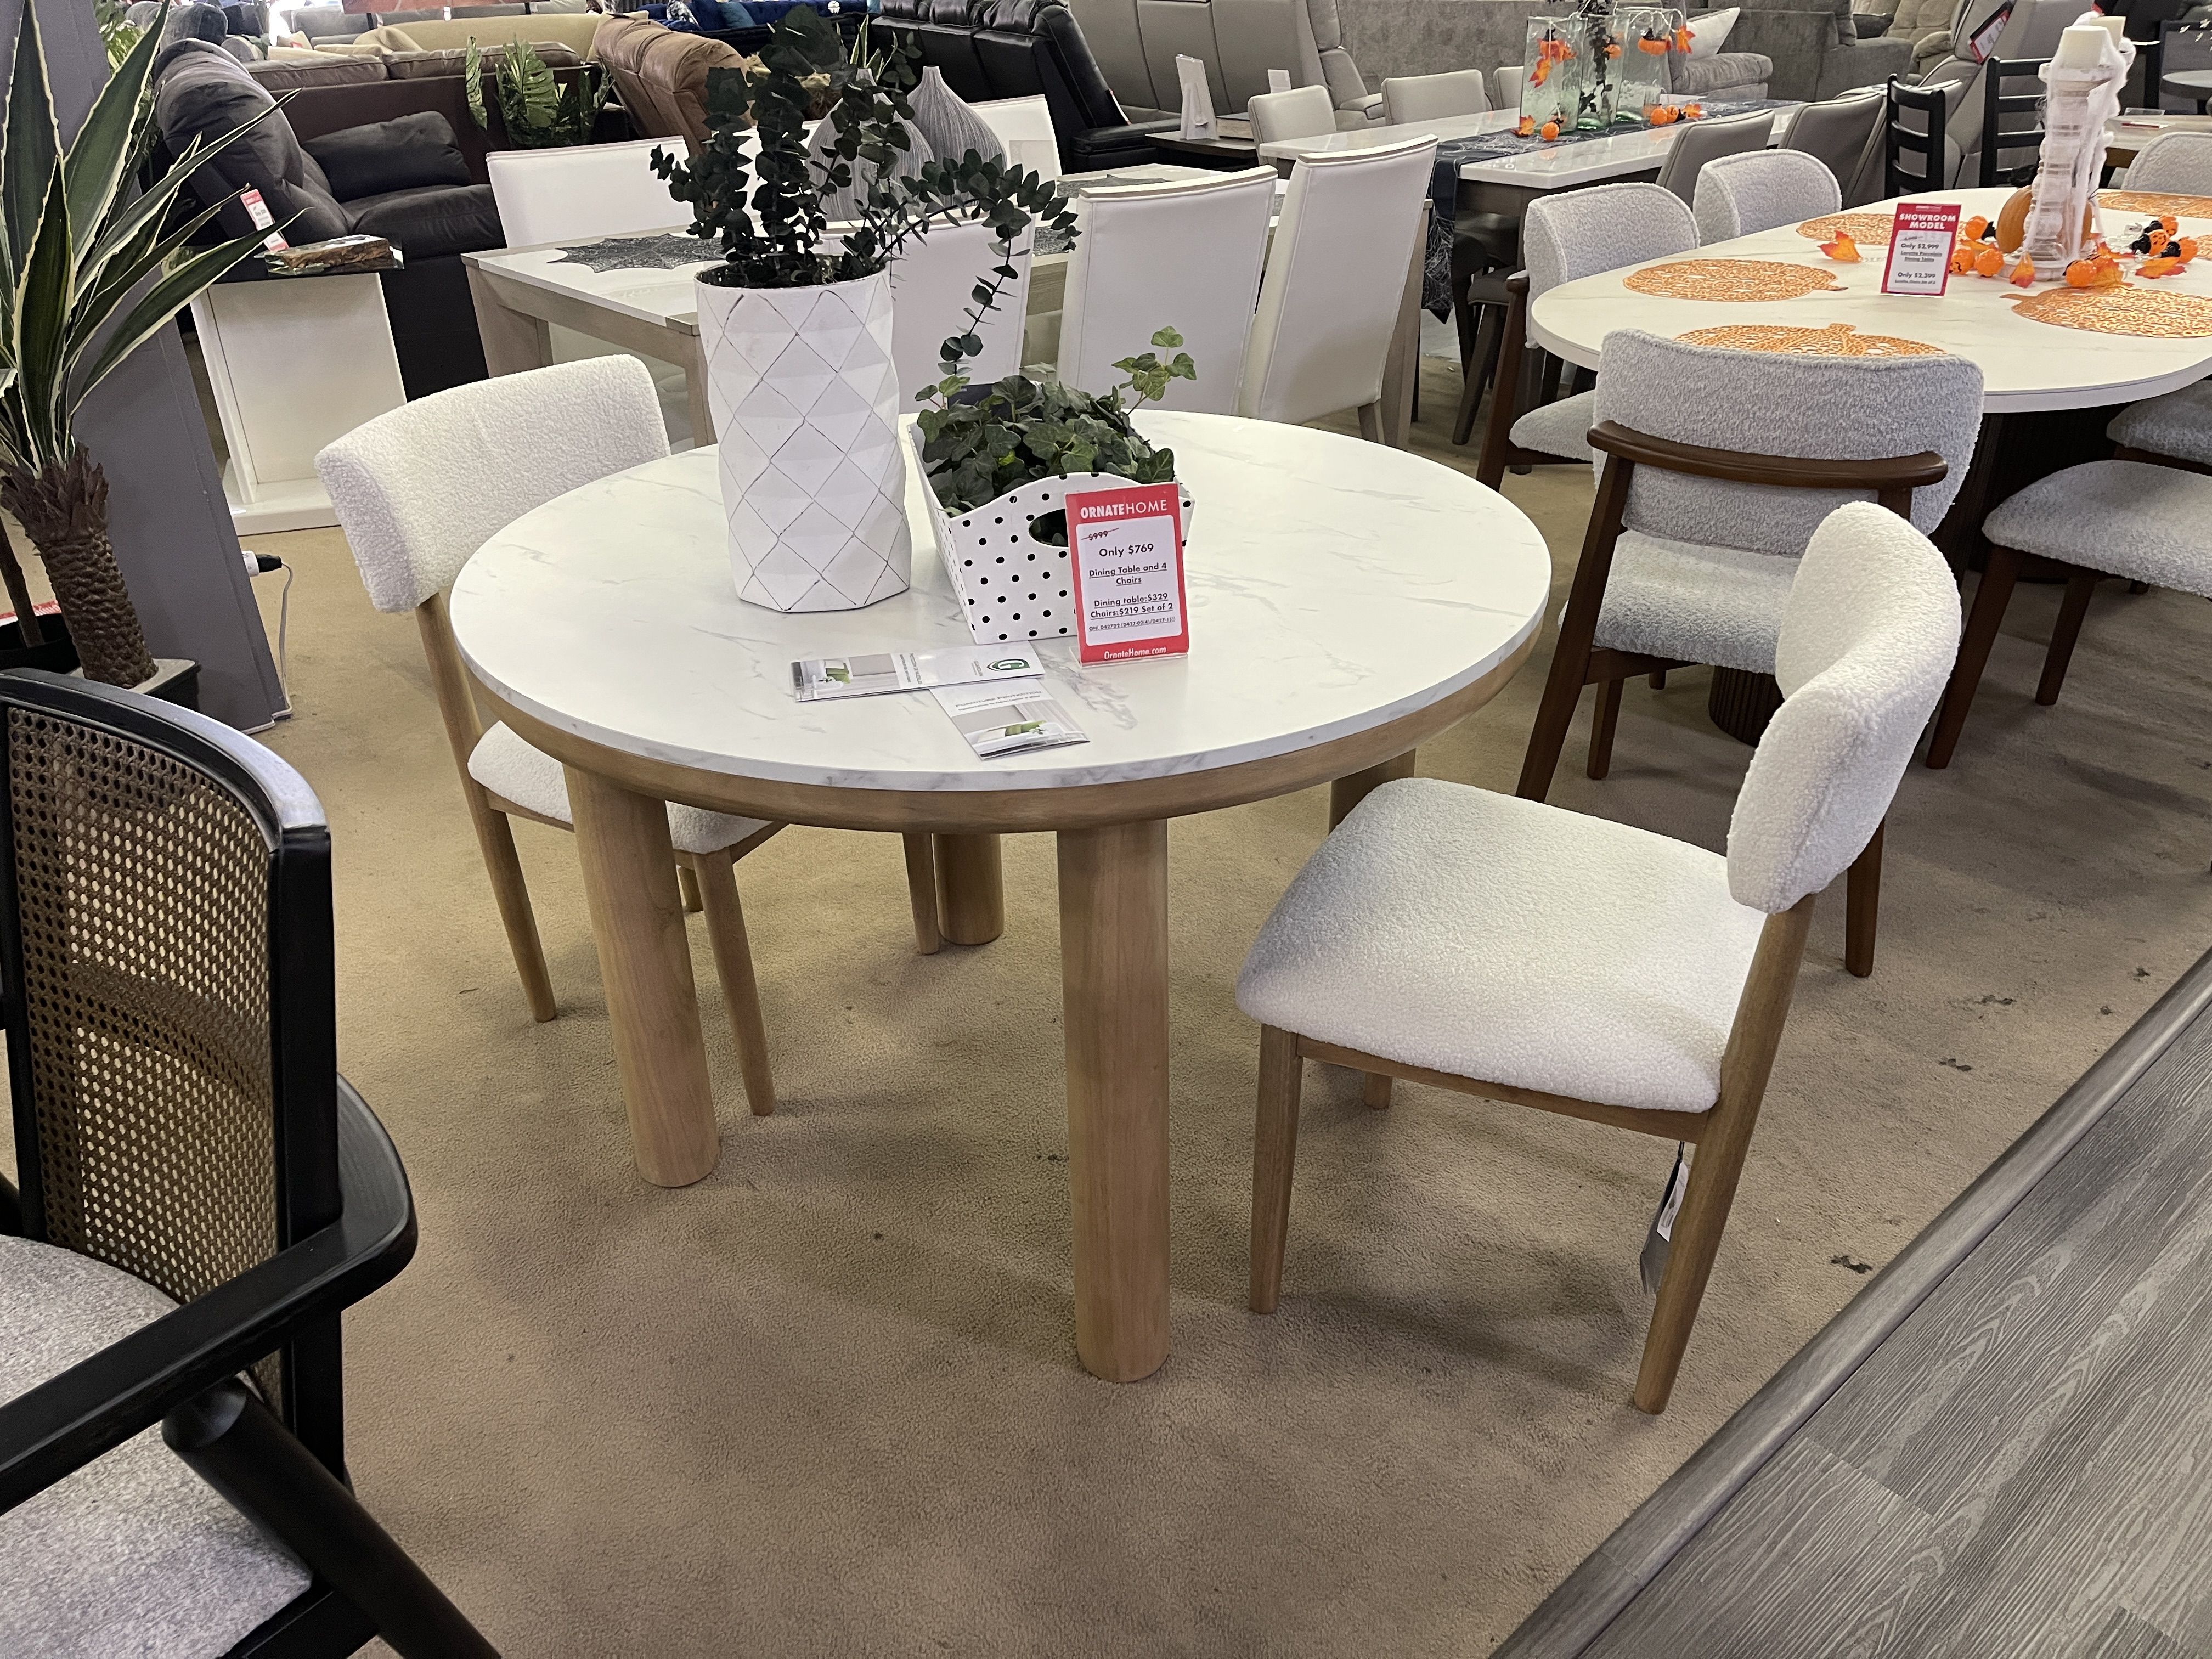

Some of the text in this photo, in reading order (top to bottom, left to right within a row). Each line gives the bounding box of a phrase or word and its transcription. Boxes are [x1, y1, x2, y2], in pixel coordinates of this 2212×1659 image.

[1899, 213, 1956, 222] SHOWROOM
[1909, 221, 1945, 230] MODEL
[1088, 530, 1108, 541] $999
[1099, 543, 1154, 557] Only $769
[1089, 568, 1116, 577] Dining
[1118, 565, 1141, 573] Table
[1143, 562, 1159, 571] and
[1116, 576, 1142, 585] Chairs
[1094, 593, 1168, 607] Dining table:$329
[1091, 607, 1139, 618] Chairs:$219
[1104, 647, 1167, 659] OrnateHome.com
[997, 690, 1042, 699] PROTECTION
